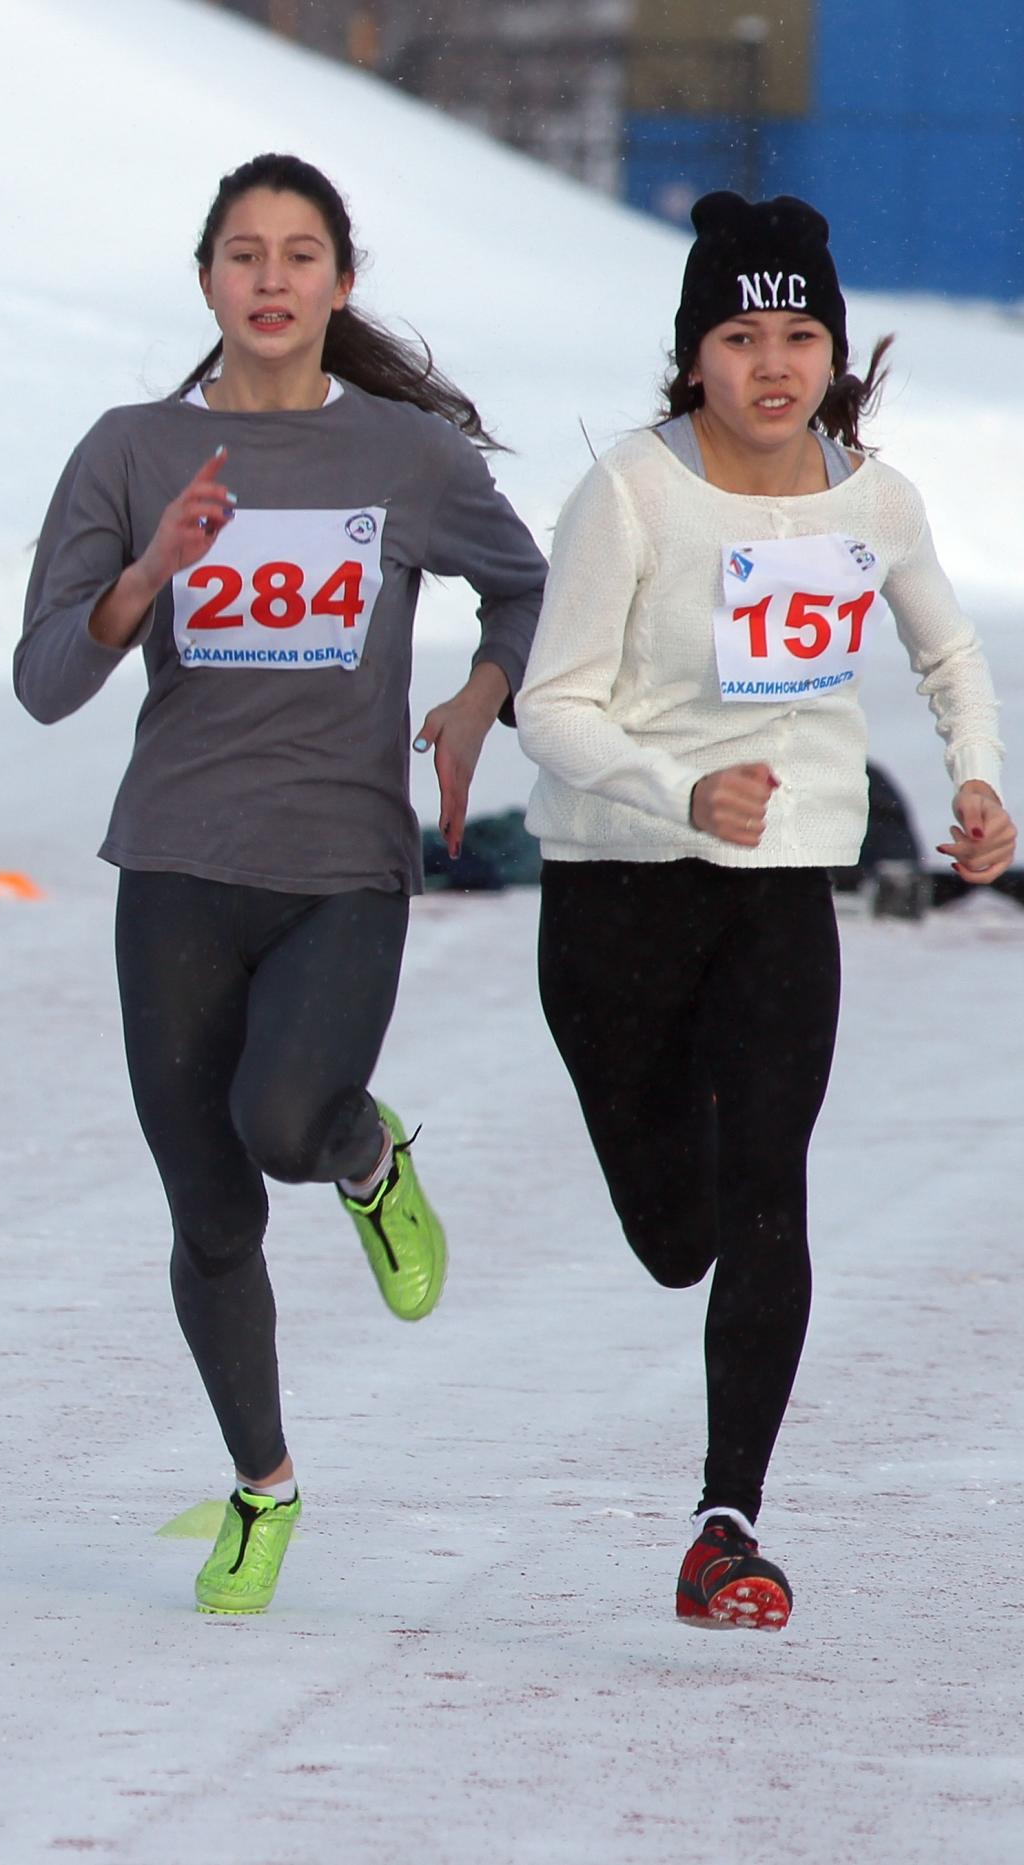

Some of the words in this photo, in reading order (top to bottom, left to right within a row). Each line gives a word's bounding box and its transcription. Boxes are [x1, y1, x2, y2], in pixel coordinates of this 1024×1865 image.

[737, 271, 807, 310] N.Y.C
[186, 560, 365, 630] 284
[733, 590, 875, 660] 151
[184, 647, 298, 662] САХАЛИНСКАЯ
[721, 680, 810, 694] САХАЛИНСКАЯ
[812, 670, 854, 690] ОБЛАСТЬ
